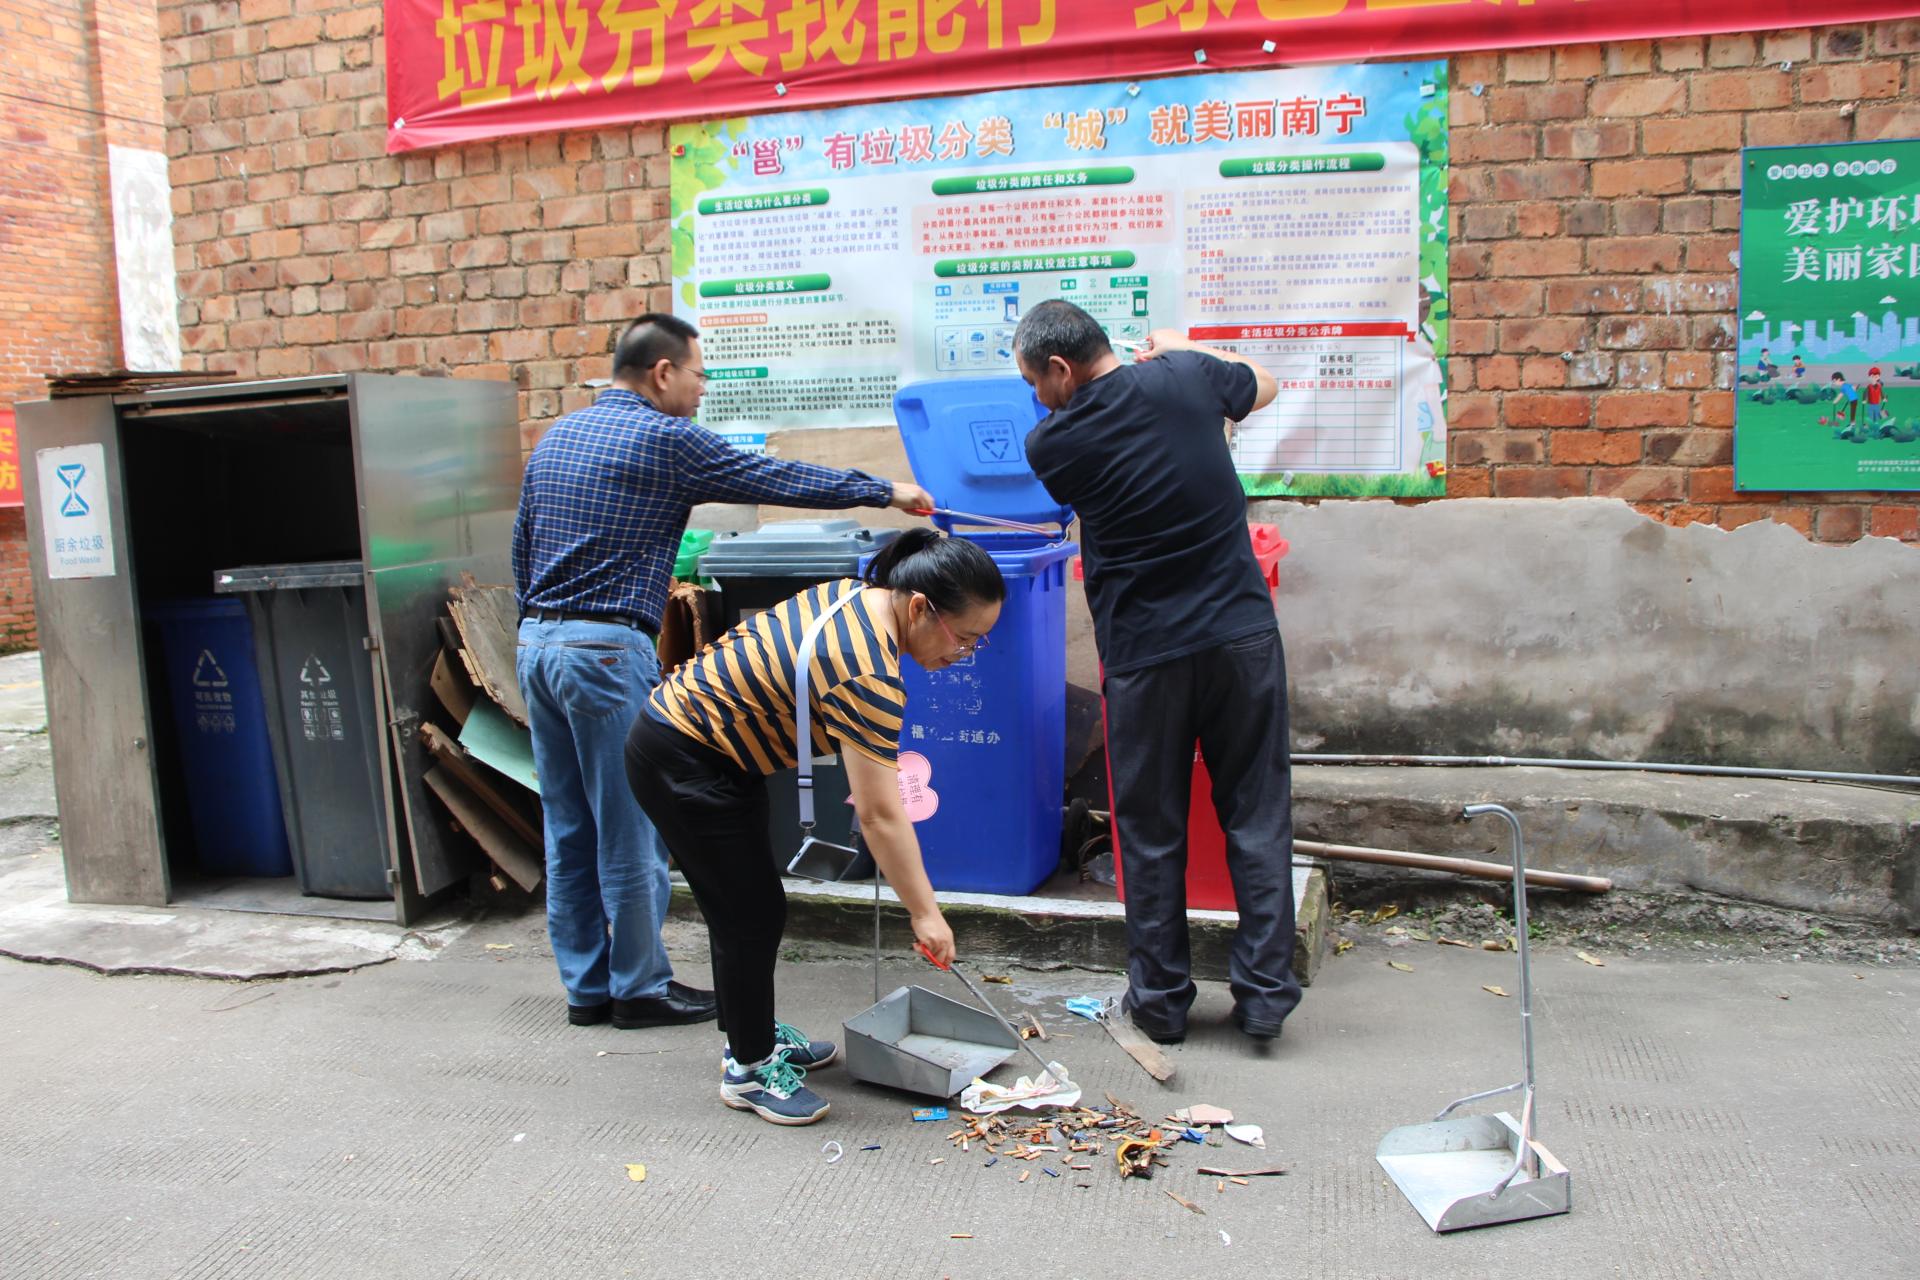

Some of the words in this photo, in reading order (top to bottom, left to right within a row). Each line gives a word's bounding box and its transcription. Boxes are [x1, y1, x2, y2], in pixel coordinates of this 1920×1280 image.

[823, 117, 1014, 170] 有垃圾分类
[1149, 94, 1366, 145] 就美丽南宁
[1252, 158, 1351, 173] 垃圾分类操作流程
[976, 172, 1088, 191] 垃圾分类的责任和义务
[1241, 326, 1344, 337] 生活垃圾分类公示牌
[1319, 355, 1353, 364] 联系电话
[1319, 367, 1353, 376] 联系电话
[54, 535, 105, 553] 厨余垃圾
